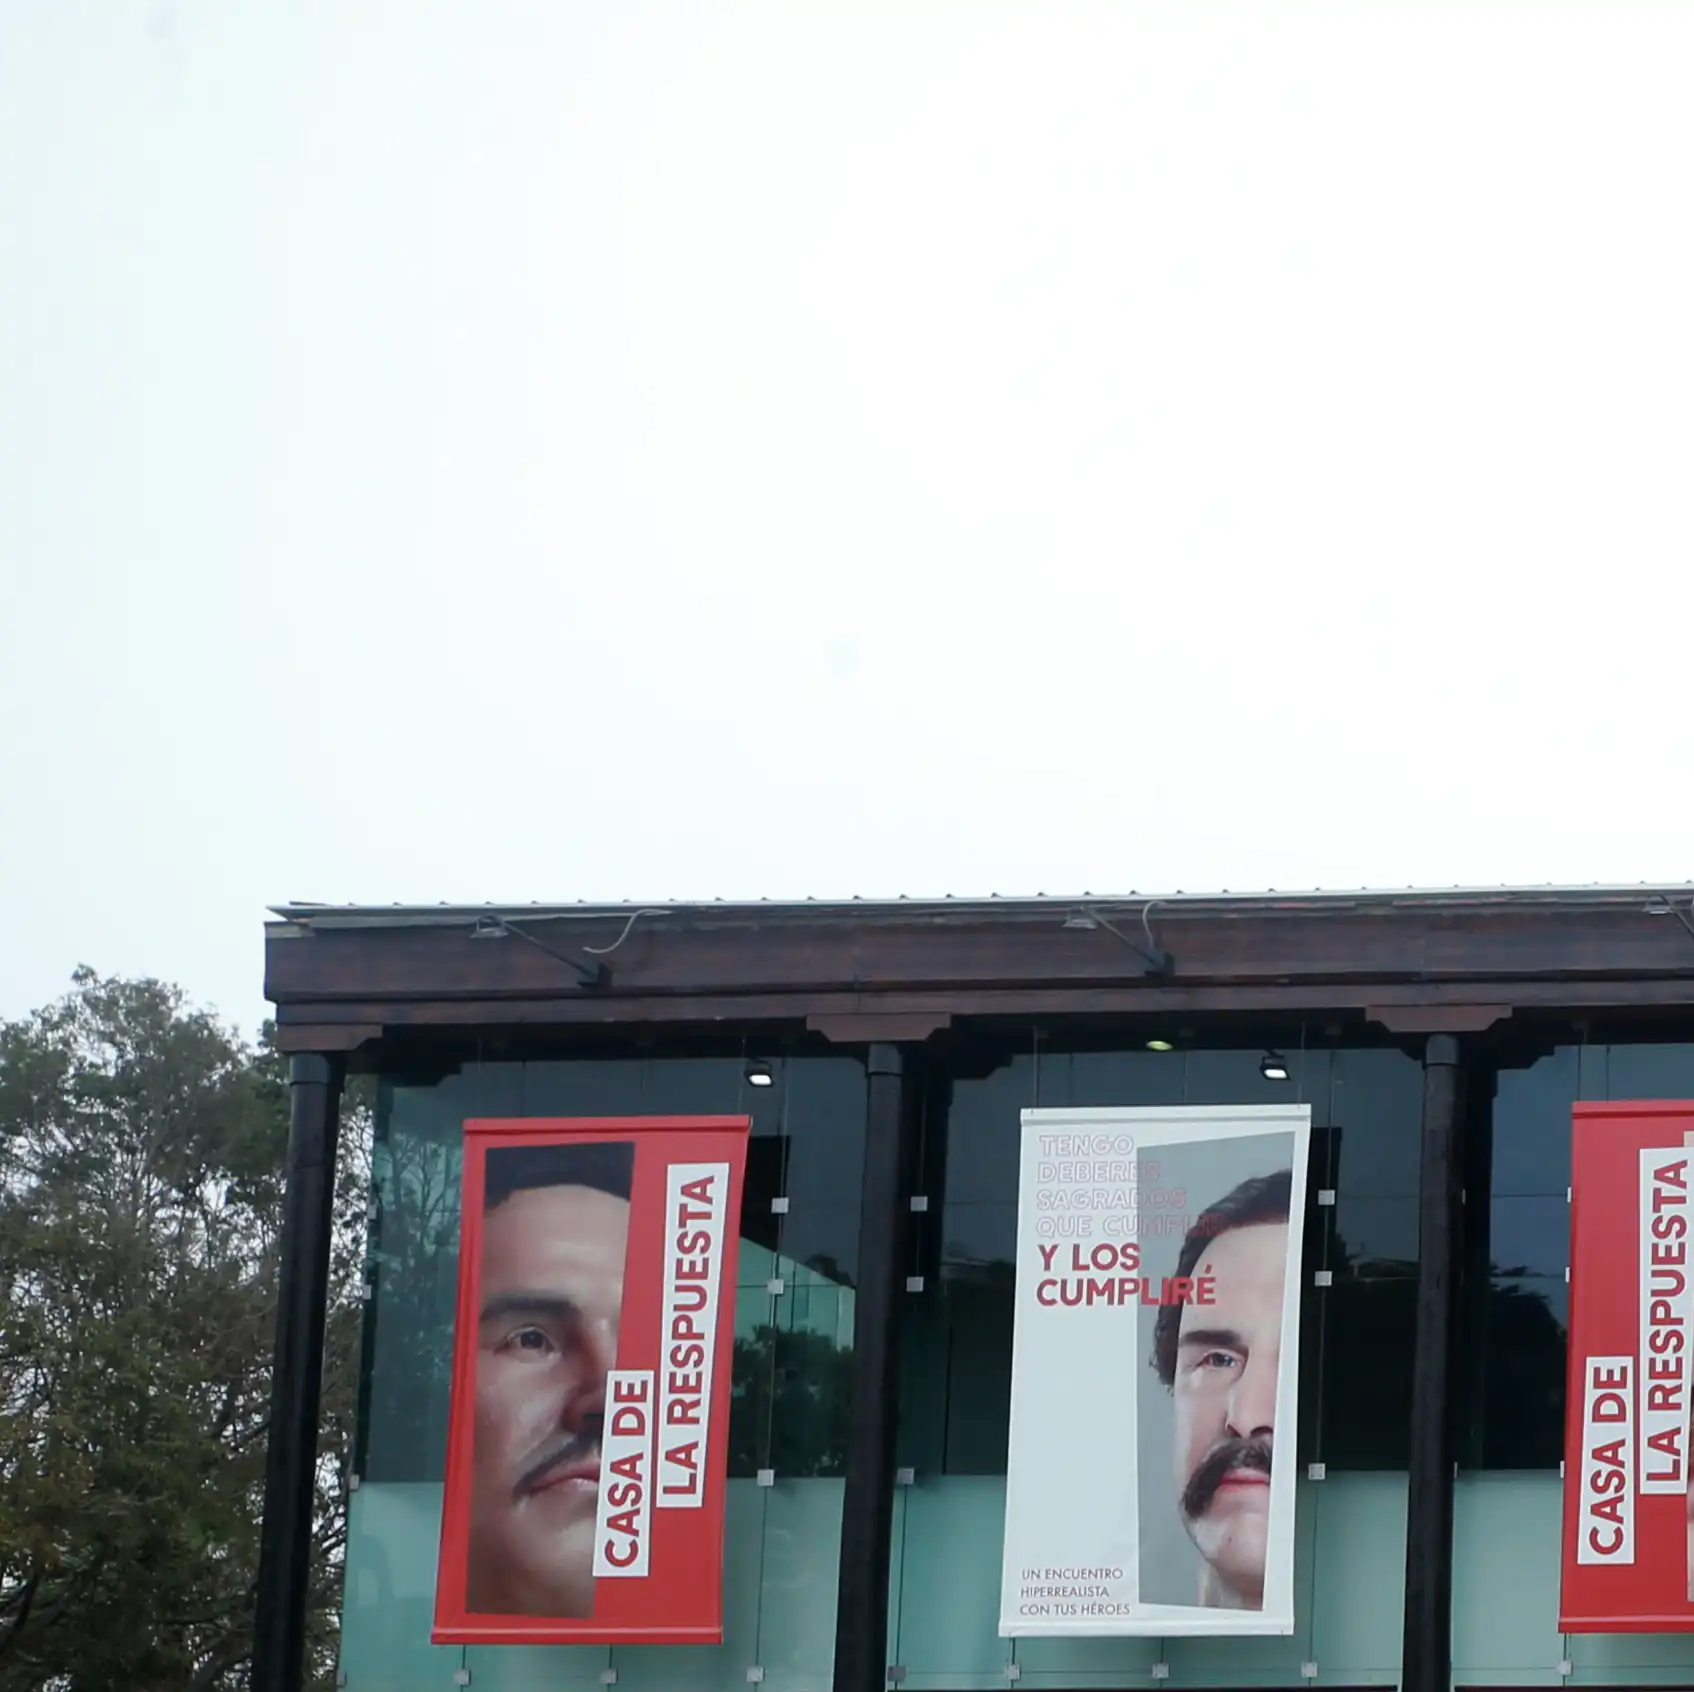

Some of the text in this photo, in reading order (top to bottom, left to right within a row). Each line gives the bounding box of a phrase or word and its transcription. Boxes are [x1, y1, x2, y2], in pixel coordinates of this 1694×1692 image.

[1039, 1134, 1134, 1157] TENGO
[1037, 1161, 1161, 1183] DEBERES
[1036, 1187, 1187, 1211] SAGRADOS
[1036, 1215, 1093, 1238] QUE
[1037, 1242, 1141, 1272] Y LOS
[1036, 1264, 1216, 1306] CUMPLIRÉ
[1646, 1160, 1688, 1482] LA RESPUESTA
[663, 1175, 715, 1495] LA RESPUESTA
[1589, 1366, 1628, 1555] CASA DE
[605, 1380, 648, 1567] CASA DE
[1022, 1568, 1123, 1580] UN ENCUENTRO
[1020, 1586, 1110, 1598] HIPERREALISTA
[1020, 1601, 1130, 1616] CON TUS HÉROES
